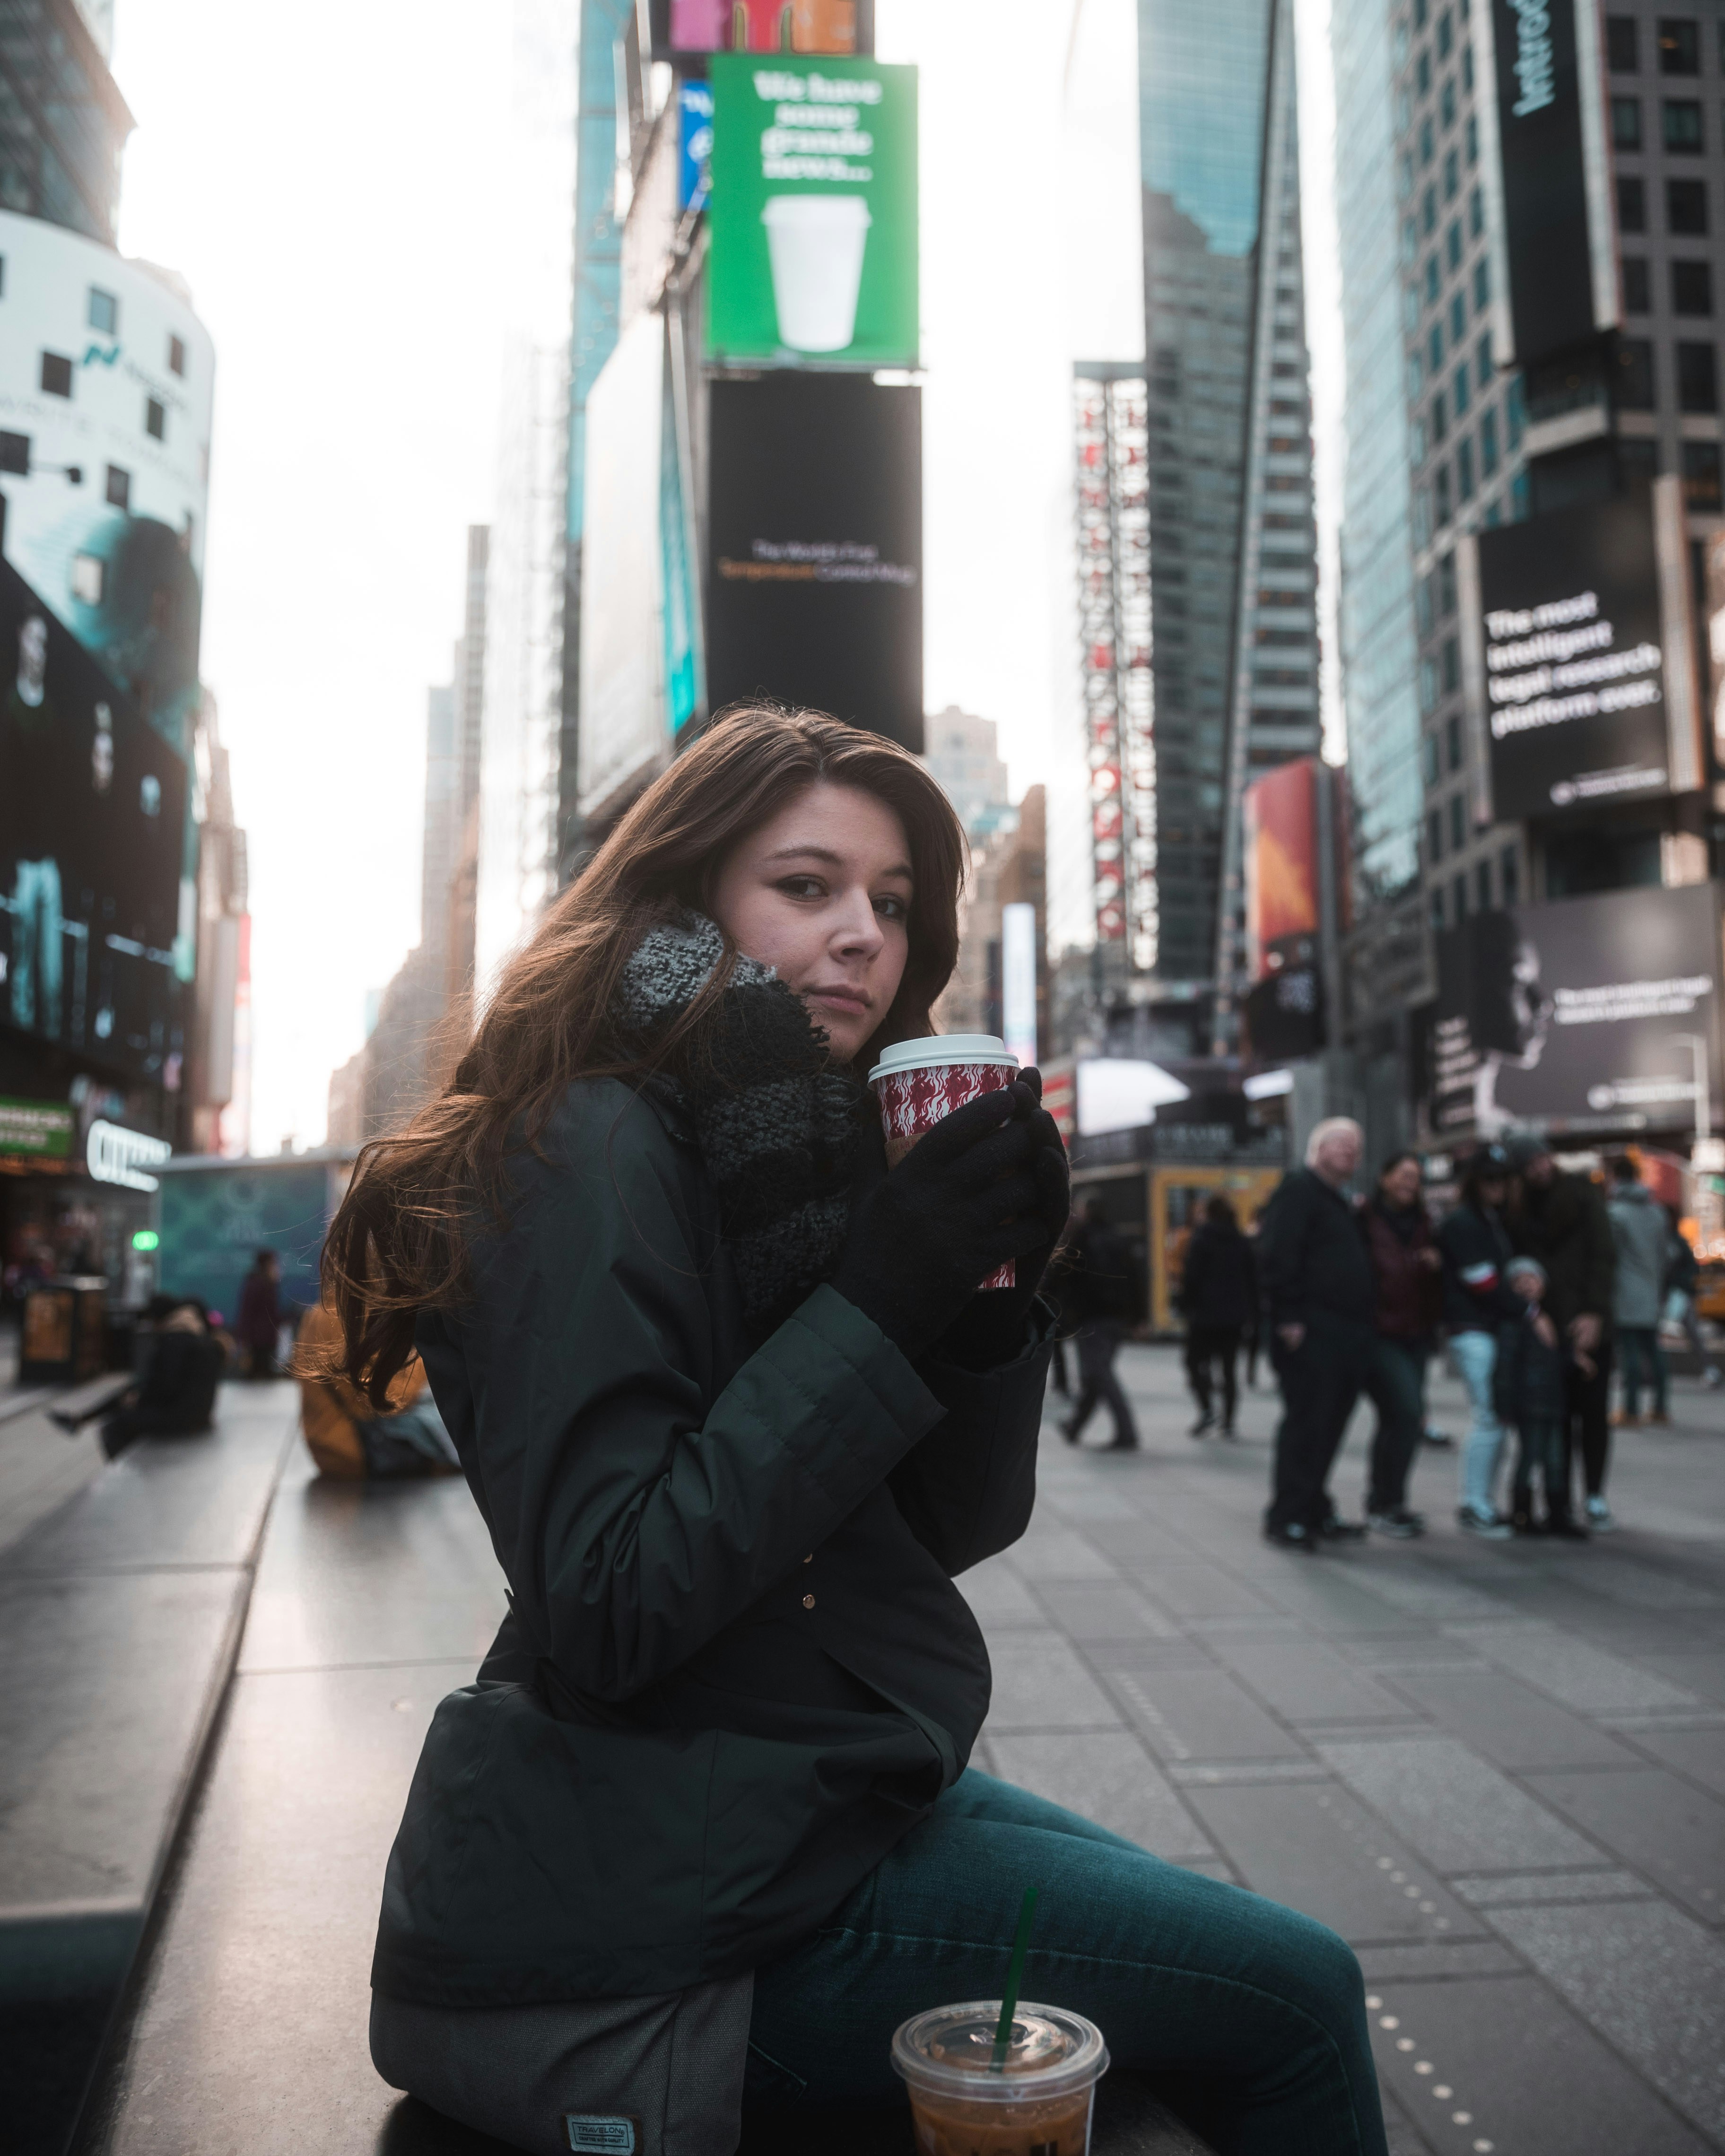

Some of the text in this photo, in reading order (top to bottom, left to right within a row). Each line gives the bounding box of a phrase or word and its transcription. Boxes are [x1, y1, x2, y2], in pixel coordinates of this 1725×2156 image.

[754, 70, 882, 104] We have
[761, 127, 874, 157] grande
[1486, 591, 1599, 639] The most
[1488, 620, 1613, 671] intelligent
[1489, 642, 1661, 704] legal research
[1491, 692, 1597, 739] platform
